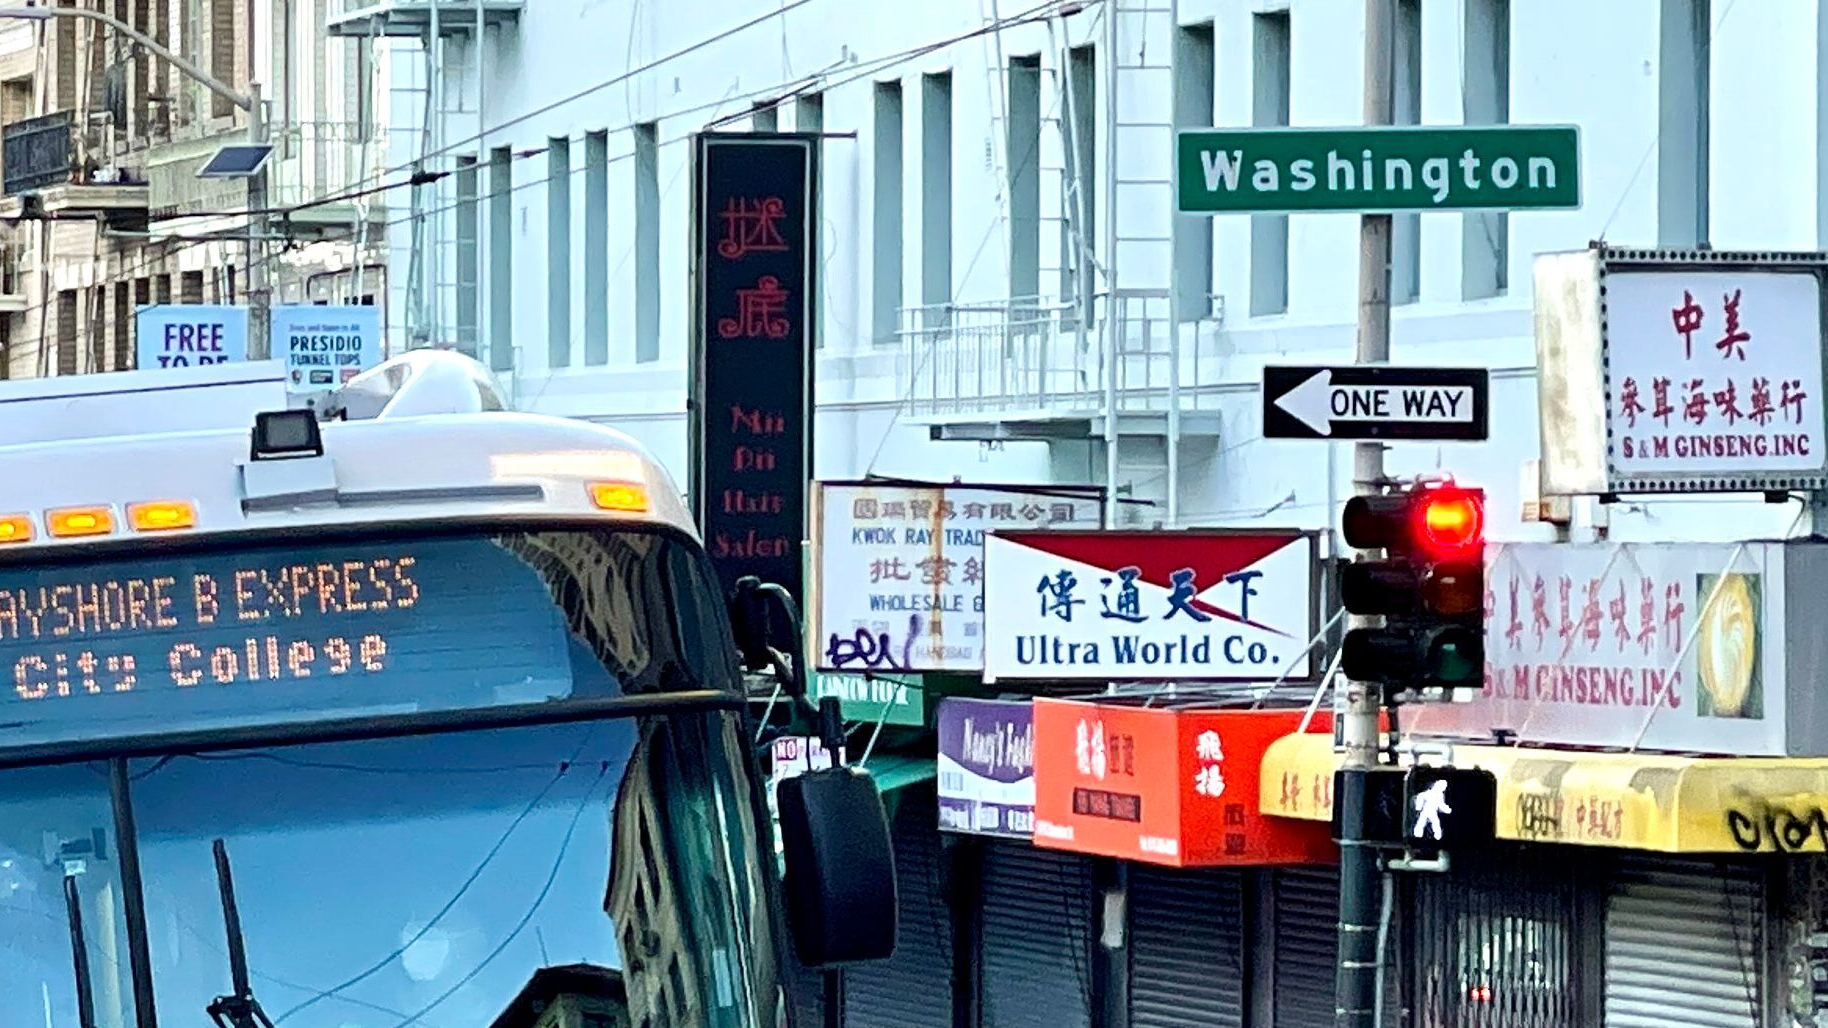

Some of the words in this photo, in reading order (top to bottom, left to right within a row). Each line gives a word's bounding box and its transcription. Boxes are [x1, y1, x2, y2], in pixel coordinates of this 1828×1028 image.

[1200, 148, 1557, 203] Washington
[164, 323, 224, 352] FREE
[1672, 288, 1751, 361] 中美
[290, 335, 362, 352] PRESIDIO
[290, 353, 331, 366] TUNNEL
[334, 353, 361, 366] TOPS
[1331, 389, 1390, 418] ONE
[1402, 389, 1465, 418] WAY
[1623, 436, 1634, 458] S
[1653, 436, 1670, 458] M
[852, 527, 896, 545] KWOK
[905, 528, 935, 545] RAY
[193, 572, 219, 625] B
[234, 556, 420, 620] EXPRESS
[868, 593, 963, 612] WHOLESALE
[1036, 565, 1264, 623] 傳通天下
[1016, 634, 1101, 665] Ultra
[1112, 634, 1211, 665] World
[1223, 635, 1280, 665] Co.
[14, 649, 137, 700] City
[170, 632, 387, 687] College
[1514, 664, 1529, 701] M
